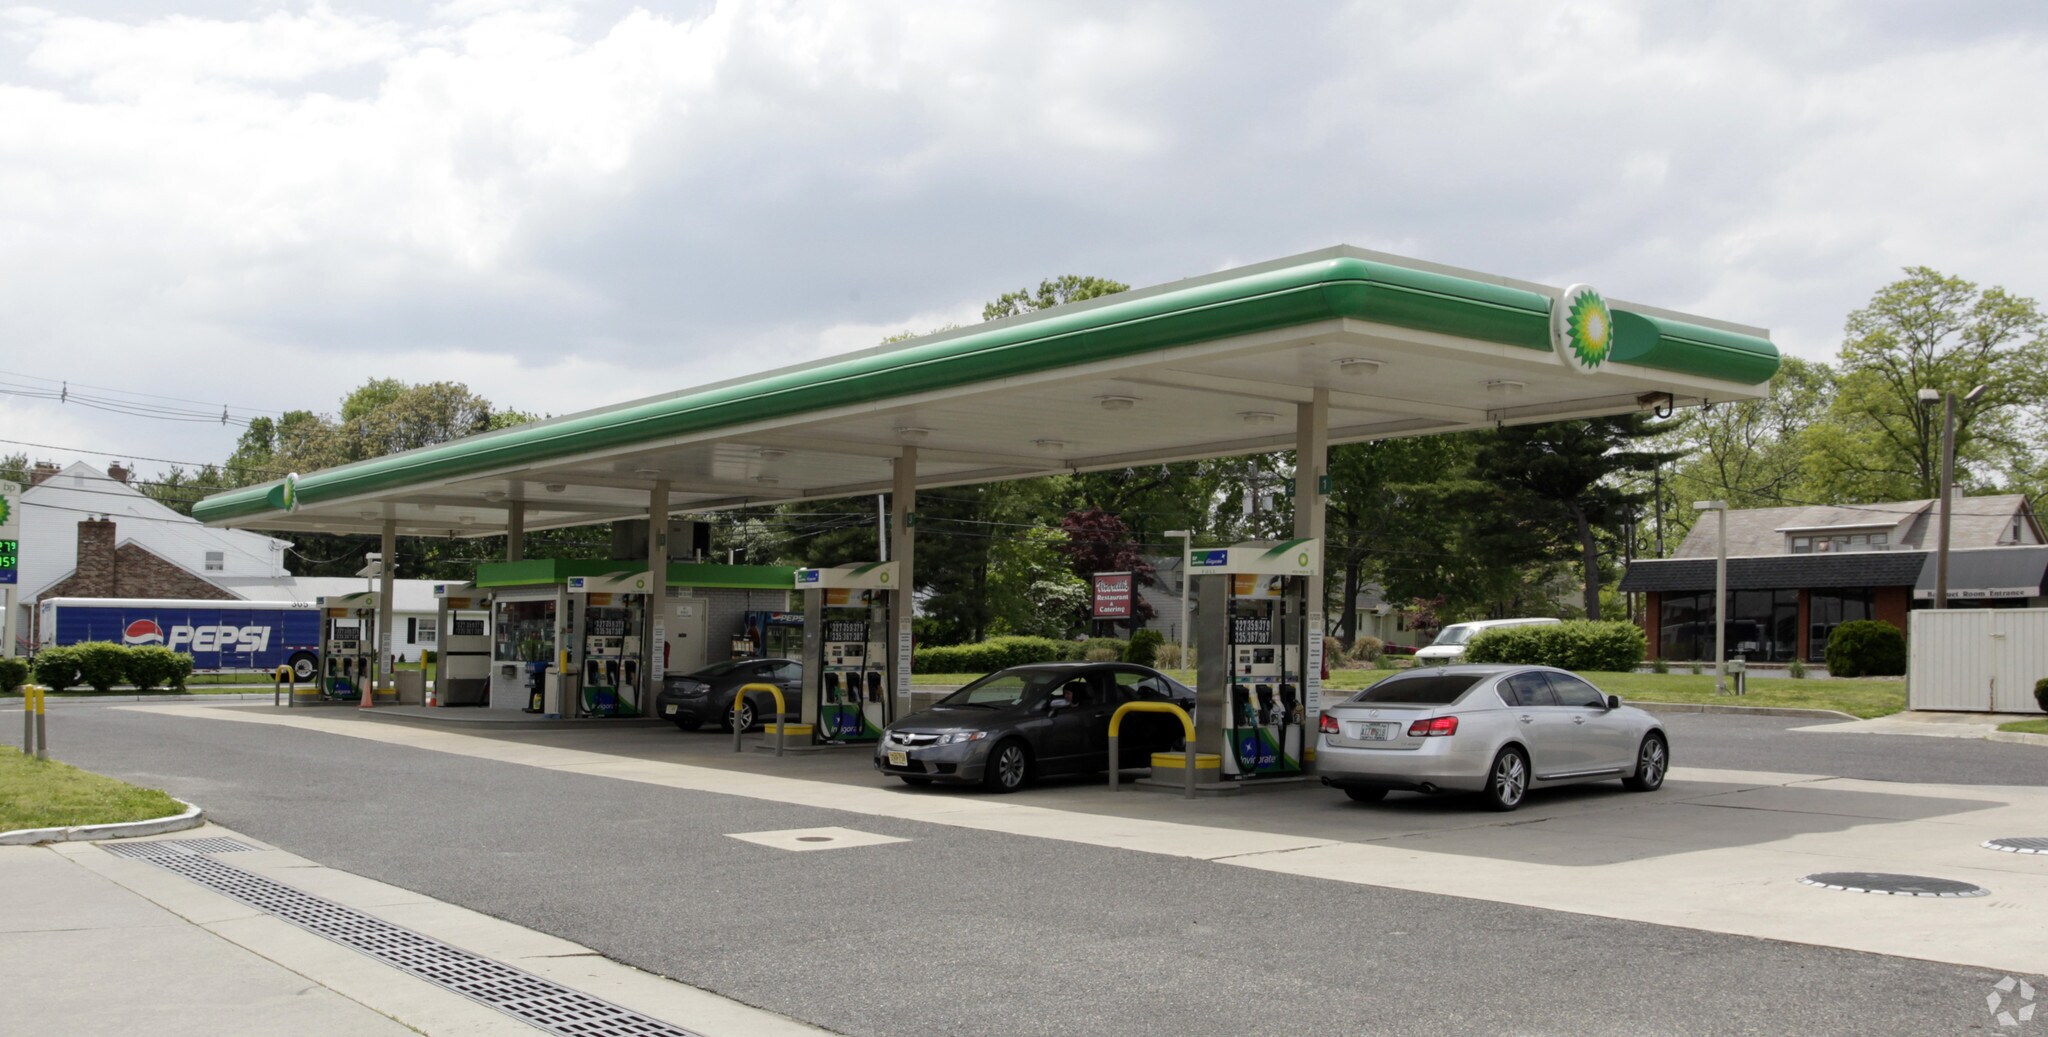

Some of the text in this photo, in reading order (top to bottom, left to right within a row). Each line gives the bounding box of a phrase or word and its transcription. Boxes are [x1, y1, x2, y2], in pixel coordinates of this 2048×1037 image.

[3, 483, 16, 492] bp
[1288, 481, 1294, 492] 2
[1322, 479, 1327, 490] 1
[1235, 620, 1270, 631] 327 359 379
[167, 625, 271, 652] PEPSI
[1235, 632, 1270, 643] 335 367 387
